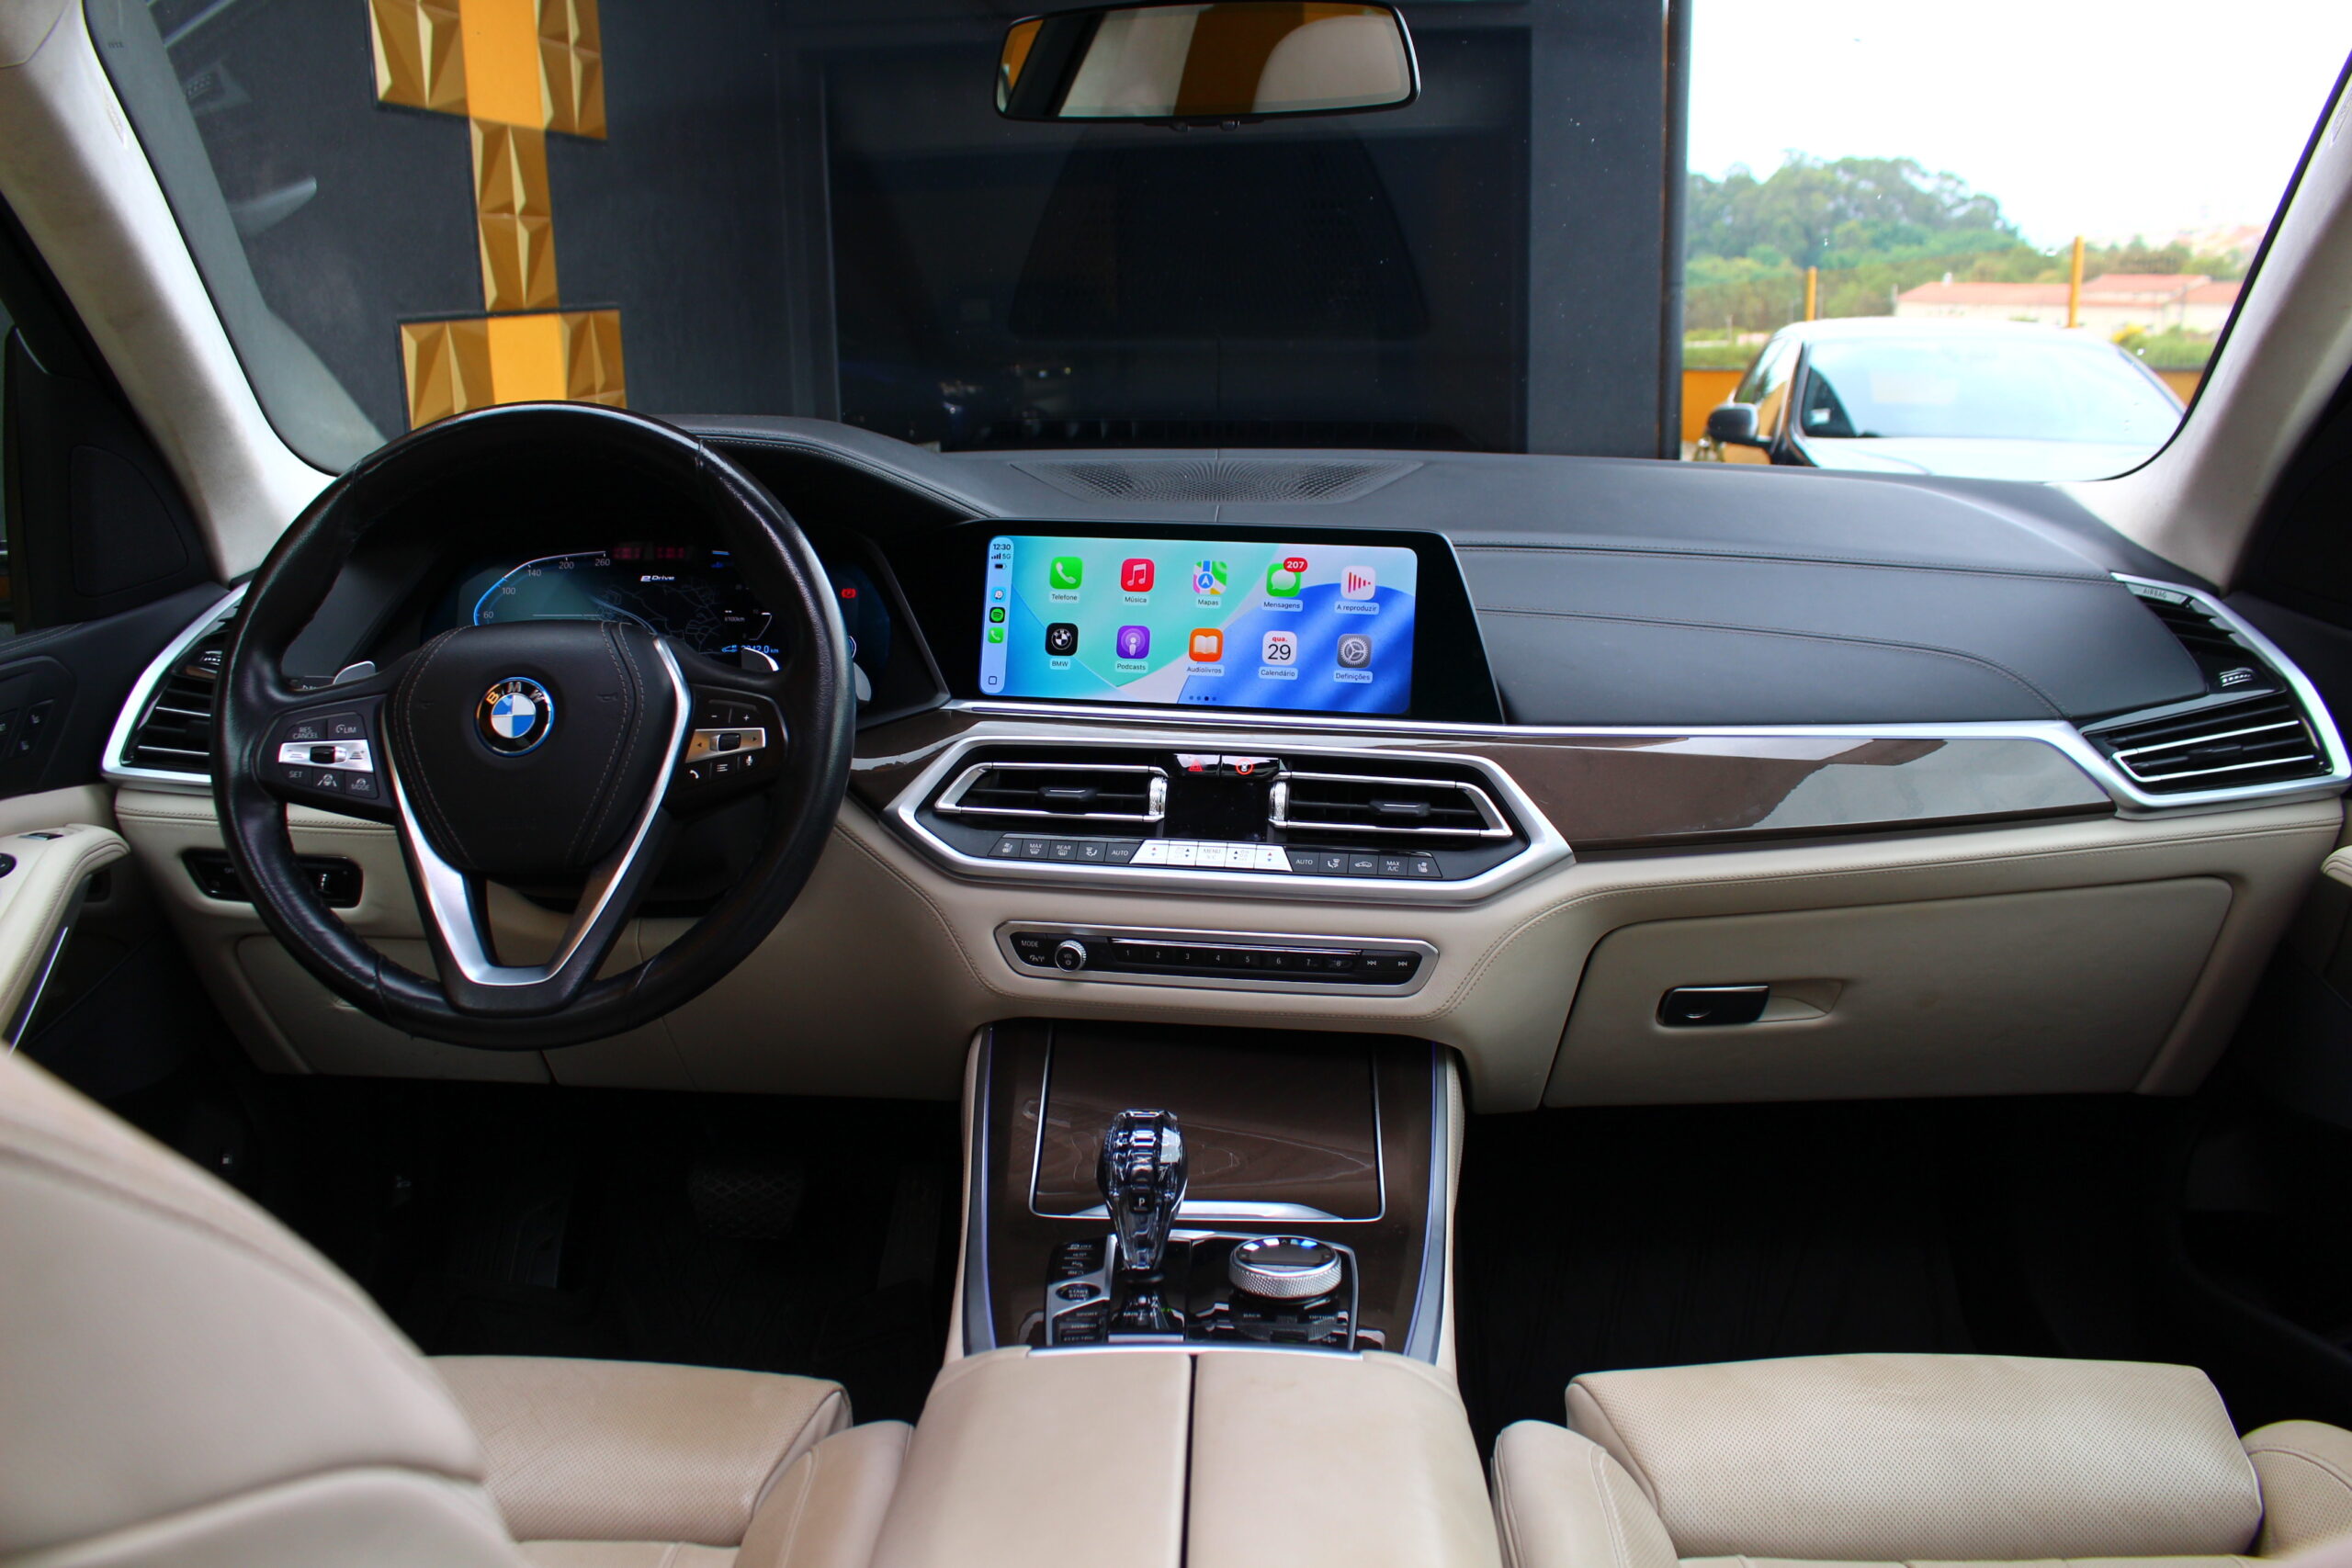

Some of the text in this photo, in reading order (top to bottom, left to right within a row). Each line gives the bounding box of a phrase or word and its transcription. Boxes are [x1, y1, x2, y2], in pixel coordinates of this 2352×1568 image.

[559, 561, 574, 570] 200
[595, 558, 610, 567] 260
[528, 569, 541, 577] 140
[502, 587, 516, 595] 100
[1051, 593, 1078, 602] Telefone
[1125, 595, 1147, 604] Música
[1197, 598, 1219, 607] Mapas
[1263, 601, 1301, 610] Mensagens
[1342, 604, 1377, 615] reproduzir
[483, 610, 494, 619] 60
[1268, 643, 1291, 660] 29
[1116, 662, 1147, 671] Podcasts
[1187, 665, 1222, 674] Audiolivros
[1261, 669, 1295, 678] Calendário
[1335, 671, 1370, 682] Definições
[485, 681, 545, 705] BMW
[292, 731, 319, 739] CANCEL
[1021, 940, 1039, 948] MODE
[1185, 952, 1190, 960] 3
[1138, 1197, 1146, 1207] P
